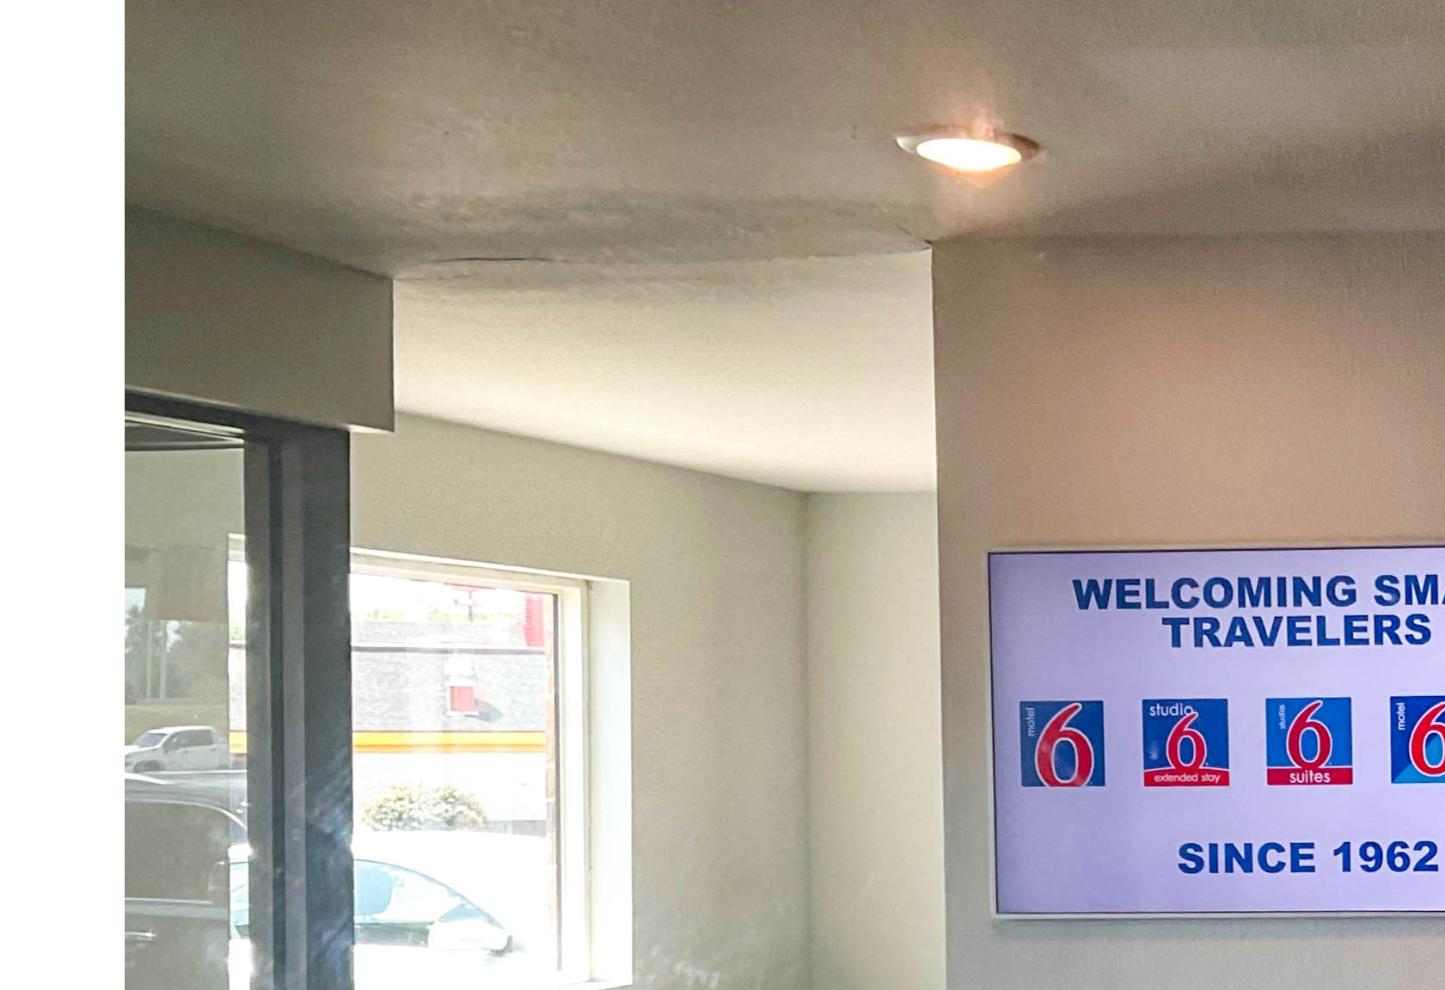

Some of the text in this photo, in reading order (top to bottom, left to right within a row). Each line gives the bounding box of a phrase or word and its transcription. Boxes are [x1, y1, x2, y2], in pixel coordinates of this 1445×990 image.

[1072, 575, 1357, 610] WELCOMING
[1162, 613, 1432, 648] TRAVELERS
[1027, 706, 1036, 737] motel
[1149, 703, 1193, 717] studio
[1397, 702, 1406, 731] motel
[1035, 702, 1094, 787] 6
[1166, 711, 1207, 769] 6
[1286, 700, 1333, 769] 6
[1154, 773, 1221, 784] extended stay
[1289, 768, 1331, 784] suites
[1178, 840, 1439, 874] SINCE 1962
